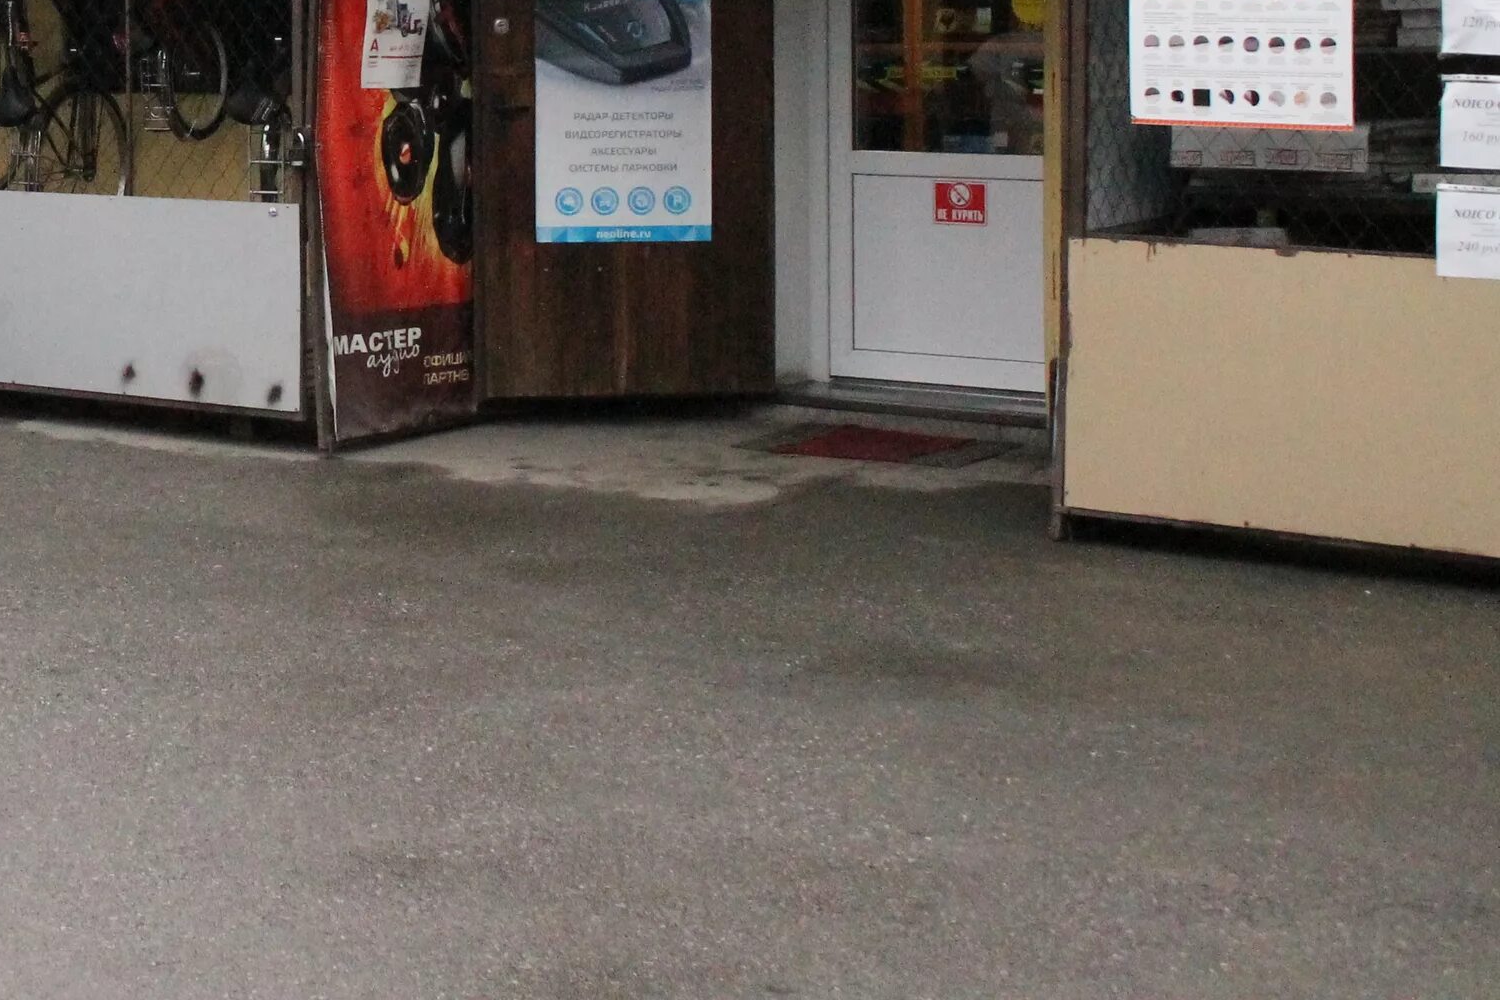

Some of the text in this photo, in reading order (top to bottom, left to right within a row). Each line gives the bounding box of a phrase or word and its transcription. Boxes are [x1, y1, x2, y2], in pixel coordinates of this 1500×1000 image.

[1452, 98, 1495, 109] NOICO
[564, 129, 682, 140] ВИДЕОРЕГИСТРАТОРЫ
[591, 147, 657, 157] АКСЕССУАРЫ
[568, 163, 678, 173] СИСТЕМЫ ПАРКОВКИ
[937, 208, 984, 222] НЕ КУРИТЬ
[1453, 208, 1495, 220] NOICO
[596, 227, 652, 239] neoline.ru
[333, 327, 422, 356] МАСТЕР
[367, 344, 420, 377] аудио
